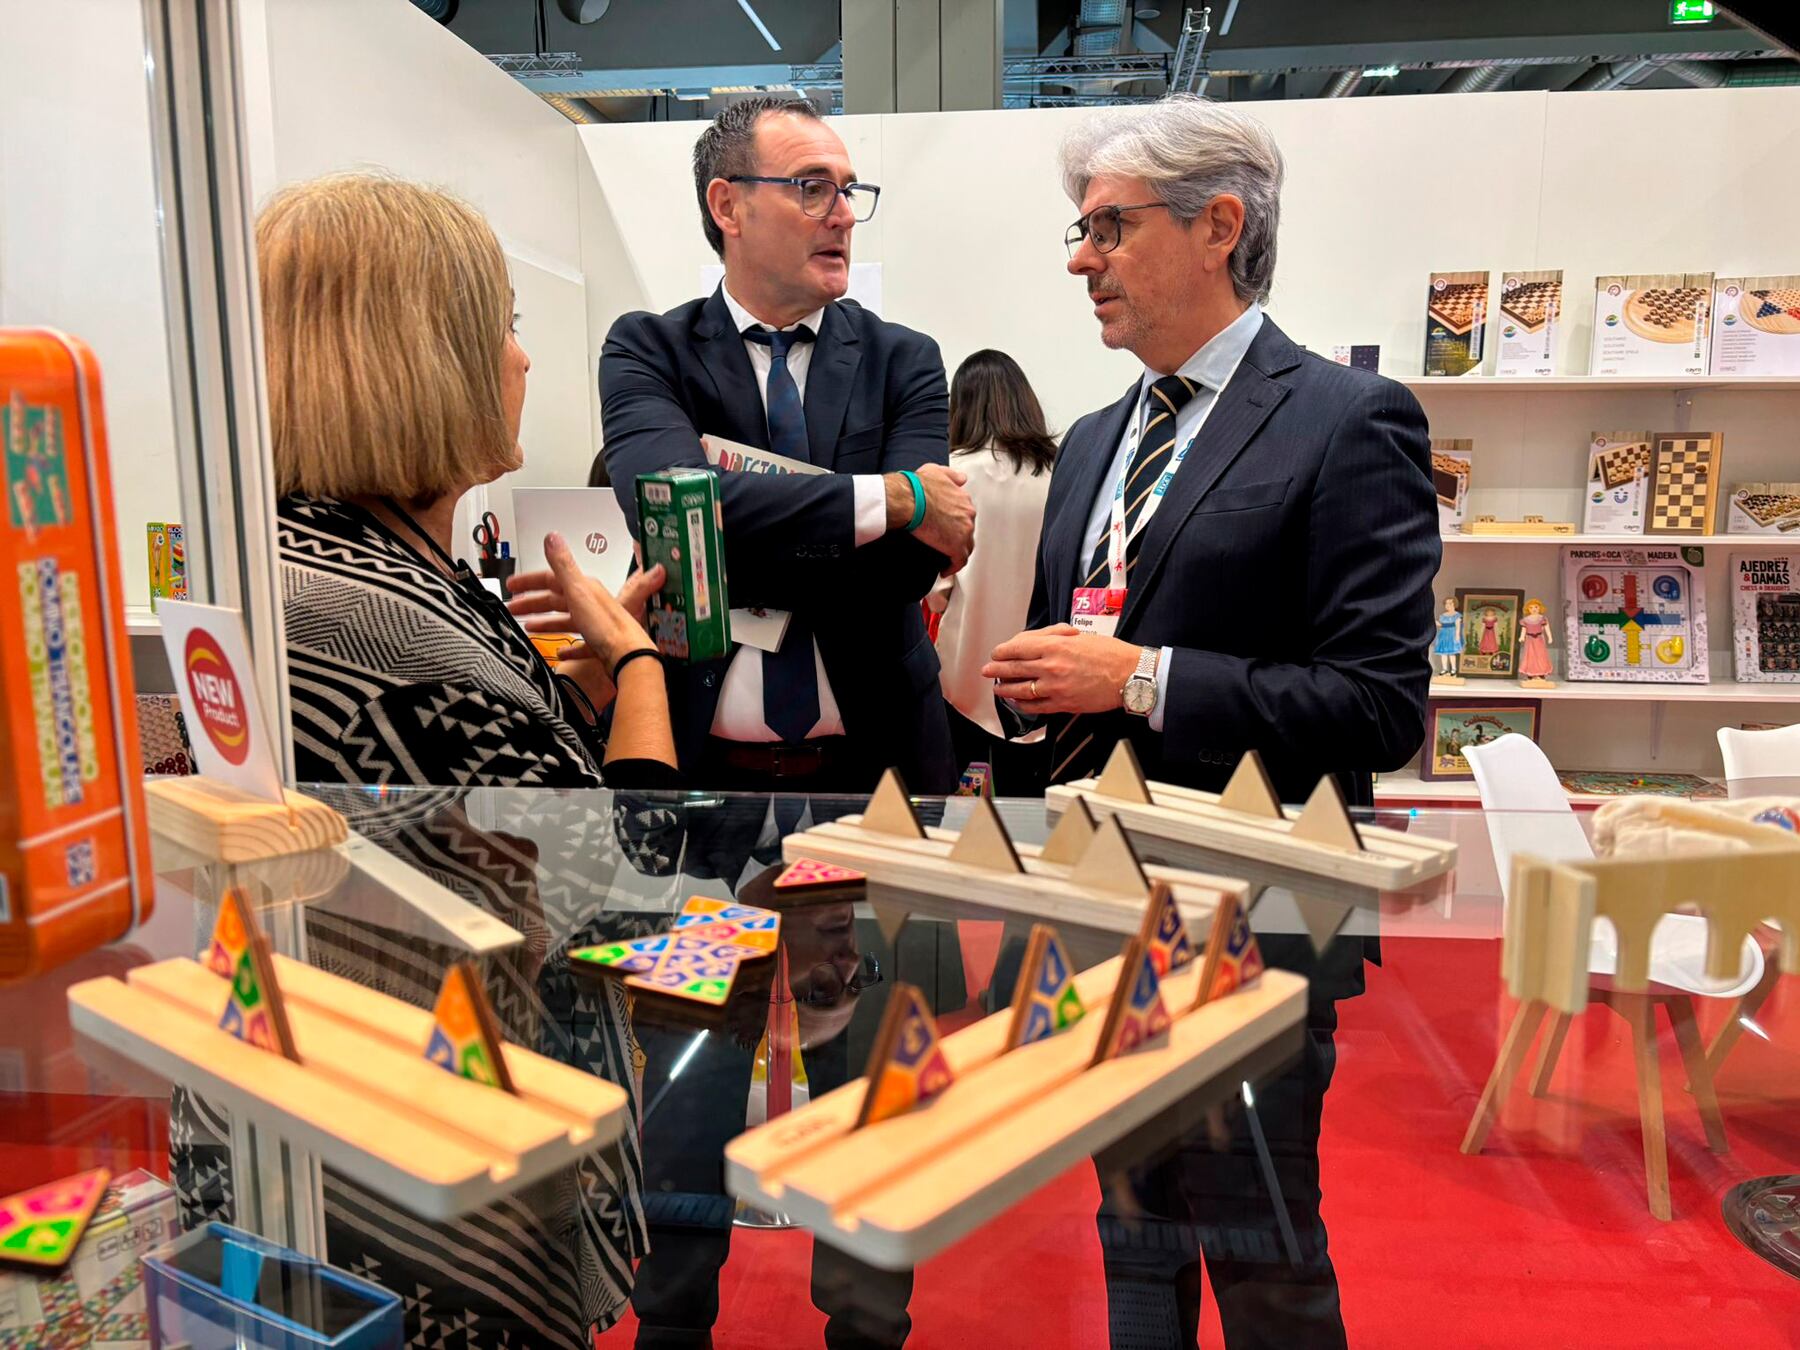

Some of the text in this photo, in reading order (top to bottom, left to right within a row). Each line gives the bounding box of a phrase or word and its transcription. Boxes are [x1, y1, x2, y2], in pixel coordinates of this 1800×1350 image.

[587, 532, 606, 554] hp
[1570, 550, 1601, 559] PARCHIS
[1606, 551, 1622, 559] OCA
[1647, 551, 1678, 560] MADERA
[1740, 560, 1790, 572] AJEDREZ
[1751, 573, 1790, 585] DAMAS
[1076, 596, 1090, 610] 75
[1074, 618, 1094, 626] Felipe
[191, 670, 236, 709] NEW
[202, 702, 241, 728] Product
